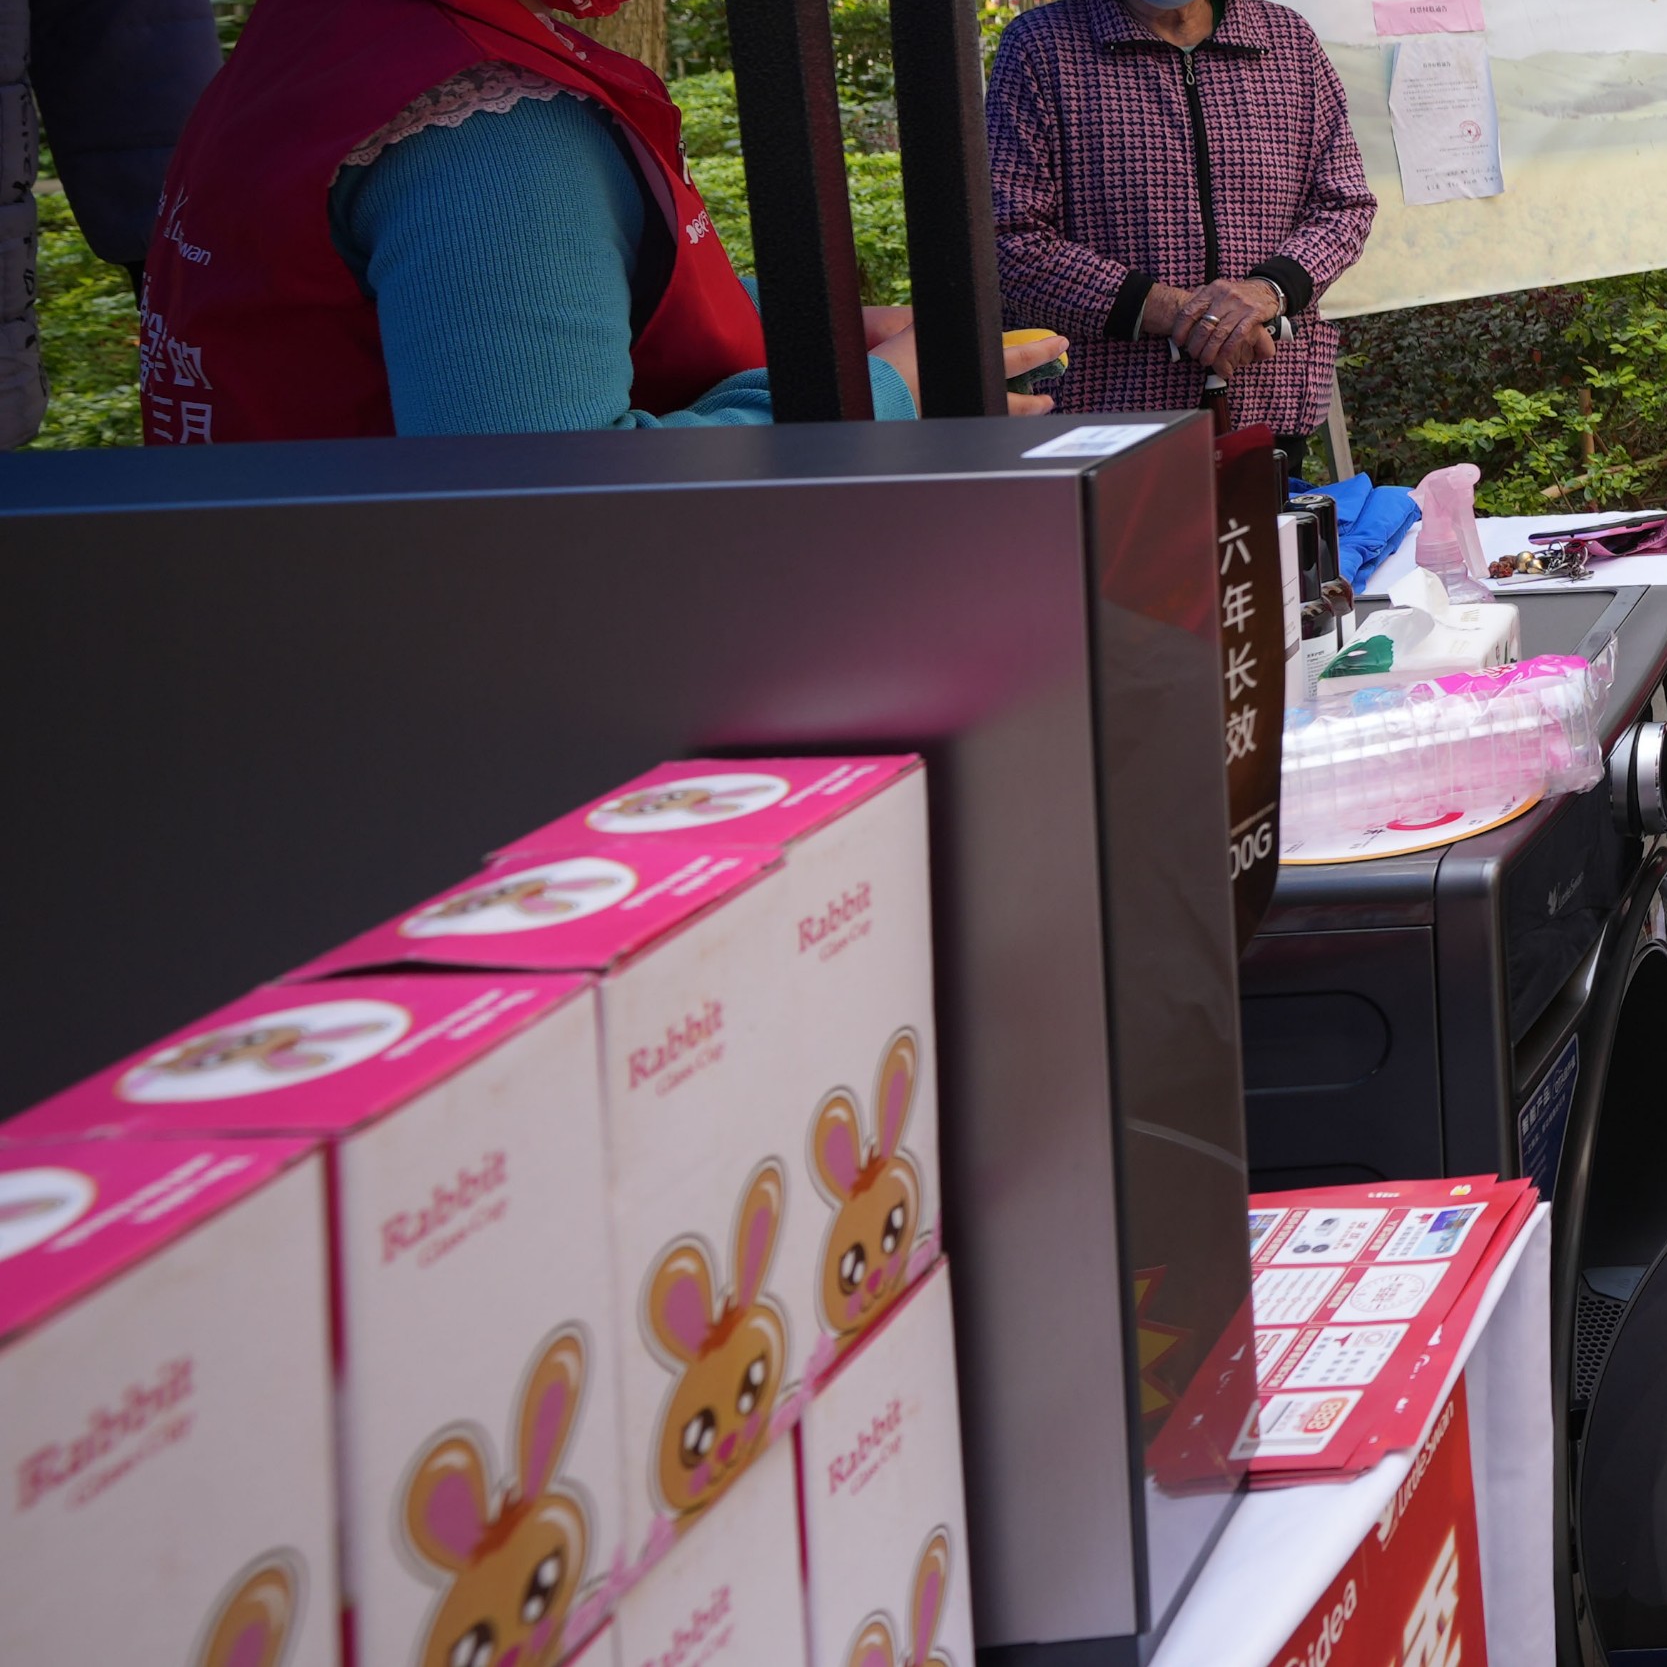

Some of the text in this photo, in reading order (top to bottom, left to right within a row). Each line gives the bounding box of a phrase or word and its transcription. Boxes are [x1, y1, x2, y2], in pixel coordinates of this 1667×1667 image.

[1218, 517, 1258, 767] 六年长效
[798, 881, 871, 953] Rabbit
[628, 1000, 724, 1091] Rabbit
[381, 1150, 507, 1265] Rabbit
[828, 1399, 902, 1495] Rabbit
